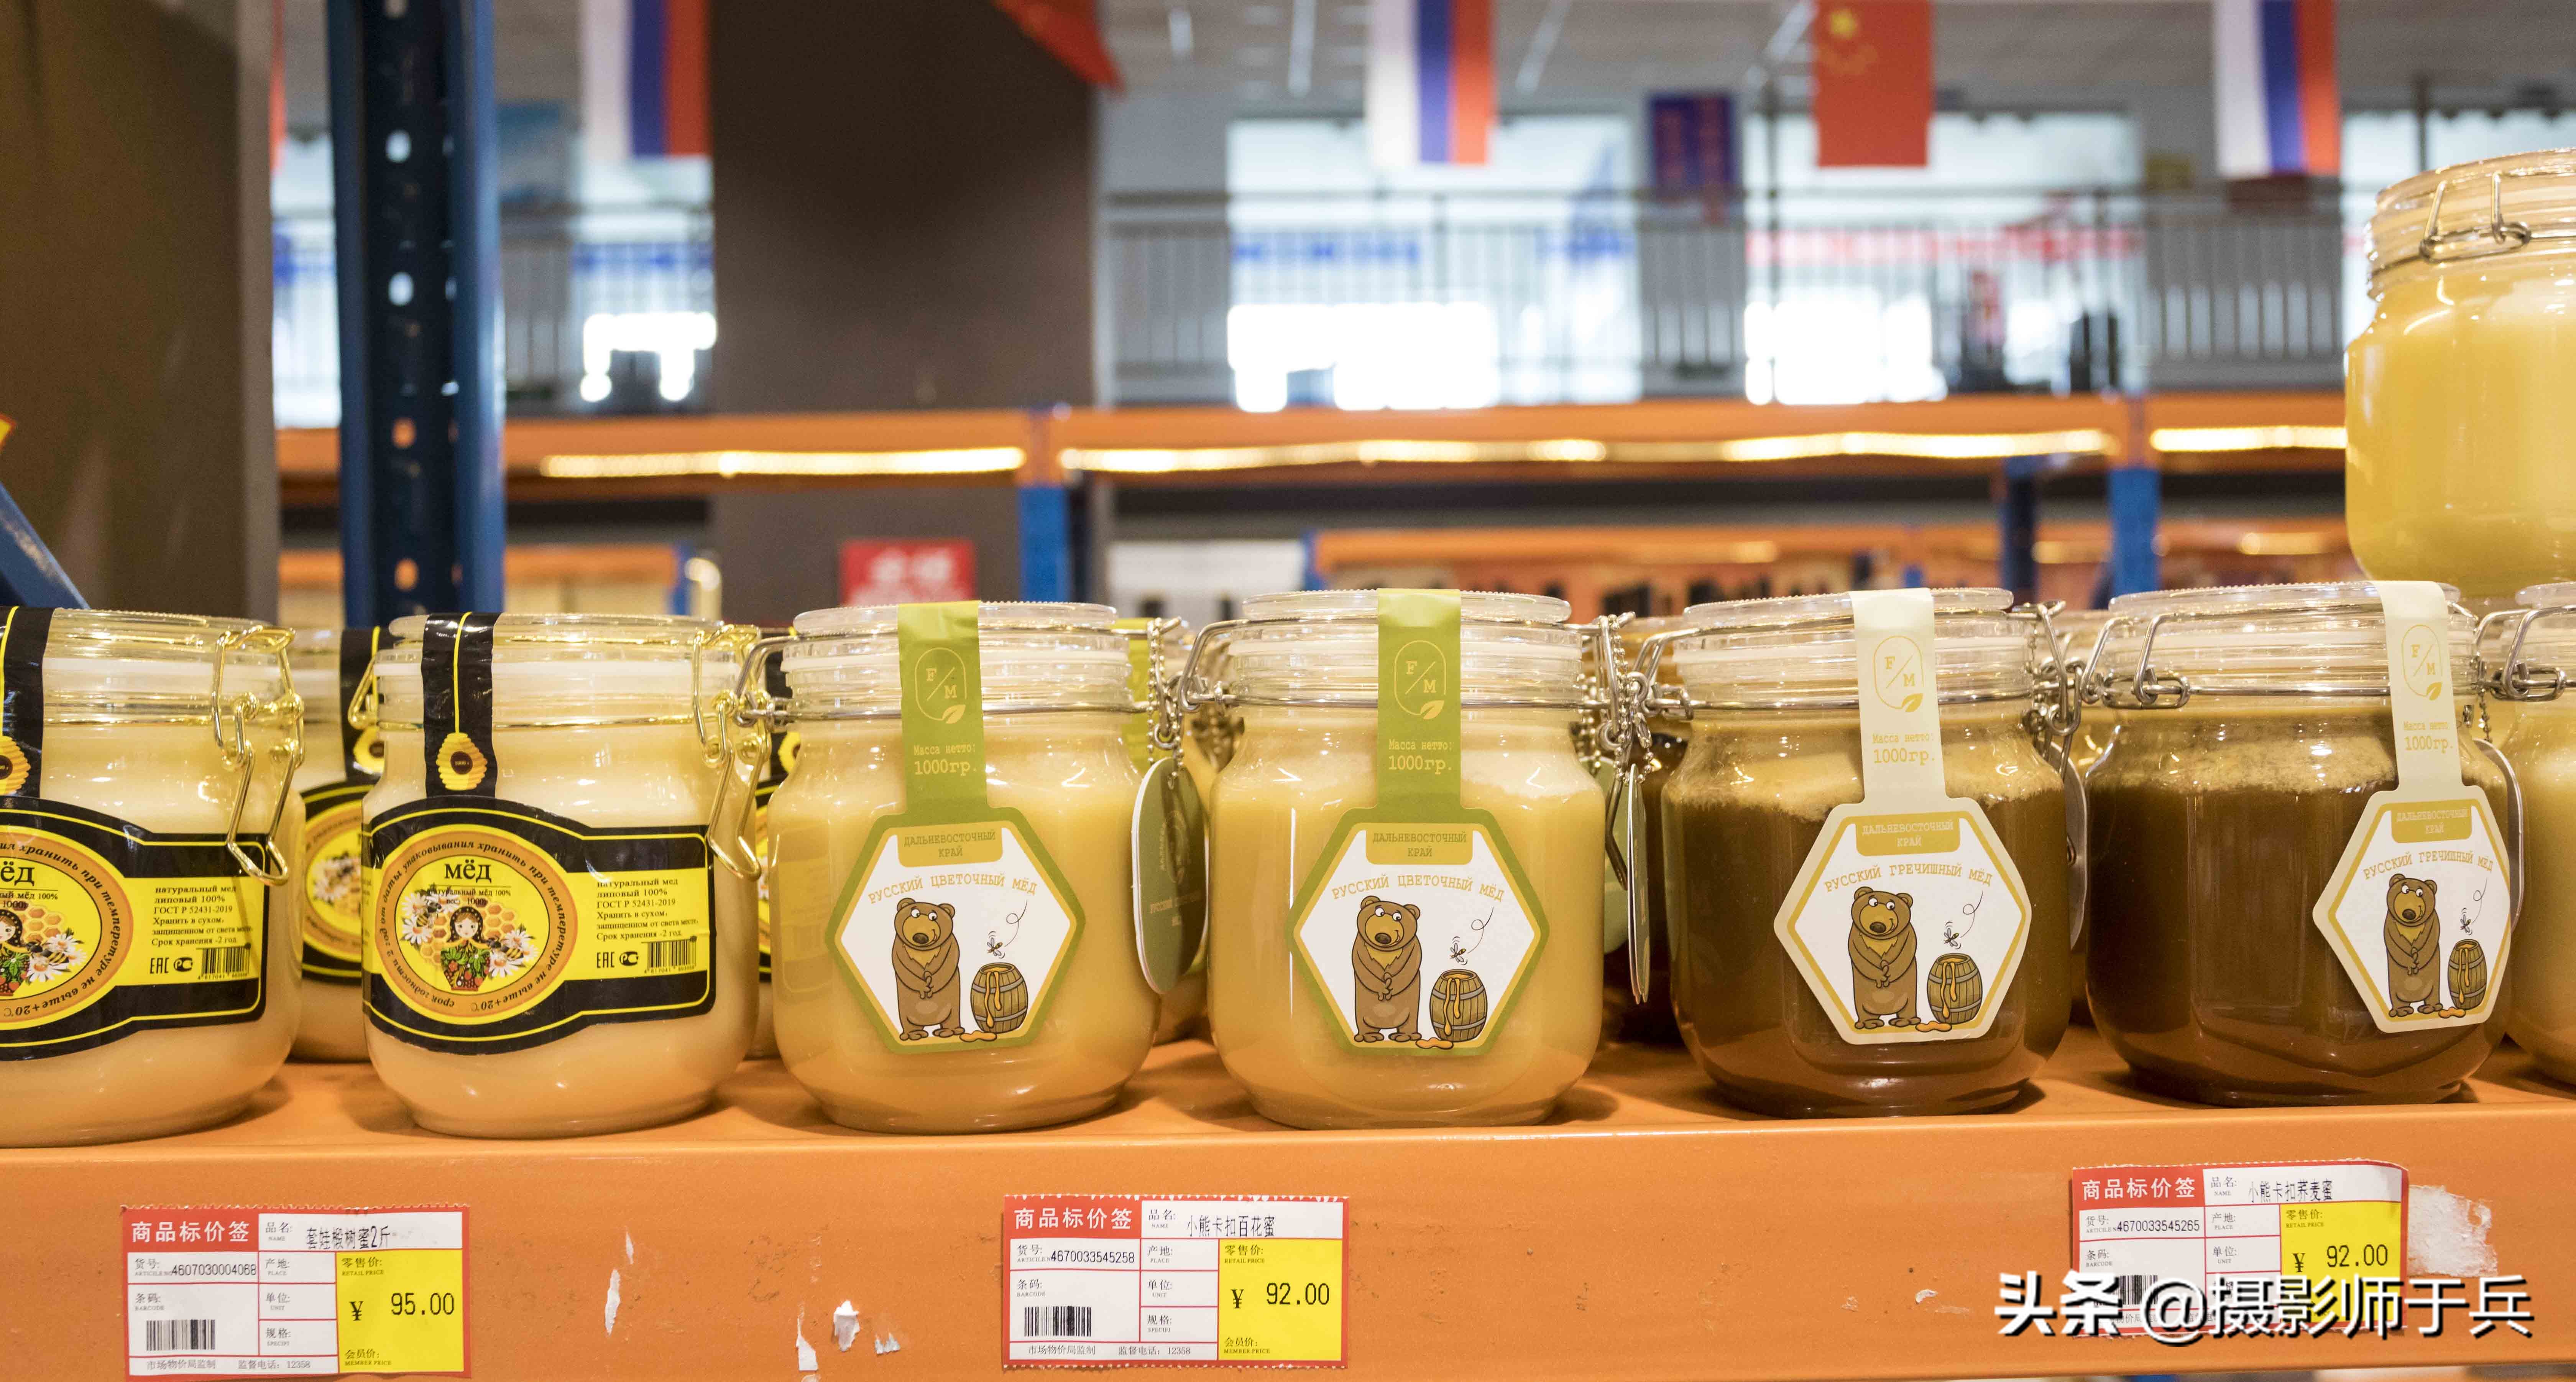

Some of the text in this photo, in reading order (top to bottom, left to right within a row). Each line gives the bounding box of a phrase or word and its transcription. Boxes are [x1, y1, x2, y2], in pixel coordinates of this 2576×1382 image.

[1389, 740, 1416, 750] Масса
[1873, 734, 1899, 744] Масса
[2405, 737, 2453, 753] 1000гр.
[914, 745, 940, 755] Масса
[1874, 748, 1934, 765] 1000гр.
[915, 760, 977, 777] 1000гр.
[1389, 756, 1452, 775] 1000гр.
[1862, 820, 1953, 835] ДАЛЬНЕВОСТОЧНЫЙ
[904, 830, 996, 847] ДАЛЬНЕВОСТОЧНЫЙ
[1372, 832, 1466, 842] ДАЛЬНЕВОСТОЧНЫЙ
[1897, 836, 1922, 847] КРАЙ
[478, 842, 526, 867] хранить
[938, 847, 963, 857] КРАЙ
[1408, 846, 1432, 857] КРАЙ
[444, 859, 491, 883] мёд
[2363, 851, 2493, 880] РУССКИЙ ГРЕЧИШНЫЙ МЁД
[529, 865, 548, 884] при
[1824, 862, 1993, 892] РУССКИЙ ГРЕЧИШНЫЙ МЁД
[155, 885, 217, 894] натуральный
[383, 870, 402, 903] даты
[597, 879, 659, 888] натуральный
[868, 872, 1037, 904] РУССКИЙ ЦВЕТОЧНЫЙ МЁД
[1332, 874, 1505, 902] РУССКИЙ ЦВЕТОЧНЫЙ МЁД
[155, 895, 197, 903] липовый
[597, 890, 639, 898] липовый
[190, 905, 232, 913] 52431-2019
[597, 898, 675, 908] ГОСТ 52431-2019
[20, 846, 102, 989] хранить при не
[153, 918, 189, 926] Хранить
[597, 912, 632, 920] Хранить
[152, 939, 172, 947] Срок
[596, 933, 617, 941] Срок
[150, 957, 169, 974] EAC
[596, 952, 614, 968] EAC
[432, 995, 455, 1007] срок
[2082, 1178, 2195, 1200] 商品标价签
[1014, 1208, 1132, 1229] 商品标价签
[2286, 1209, 2323, 1220] 零售价:
[131, 1221, 249, 1242] 商品标价签
[1187, 1214, 1275, 1237] 小熊卡扣百花蜜
[2117, 1220, 2199, 1232] 4670033545265
[1225, 1245, 1263, 1255] 零售价:
[2327, 1244, 2388, 1267] 92.00
[342, 1257, 382, 1268] 零售价:
[1051, 1250, 1134, 1263] 4670033545258
[1267, 1283, 1329, 1305] 92.00
[391, 1293, 454, 1315] 95.00
[1224, 1338, 1258, 1347] 会员价:
[345, 1349, 379, 1359] 会员价:
[1028, 1346, 1095, 1355] 市场物价局监制
[1119, 1346, 1160, 1355] 监督电话:
[147, 1359, 310, 1369] 市场物价局监制 监督电话: 12358
